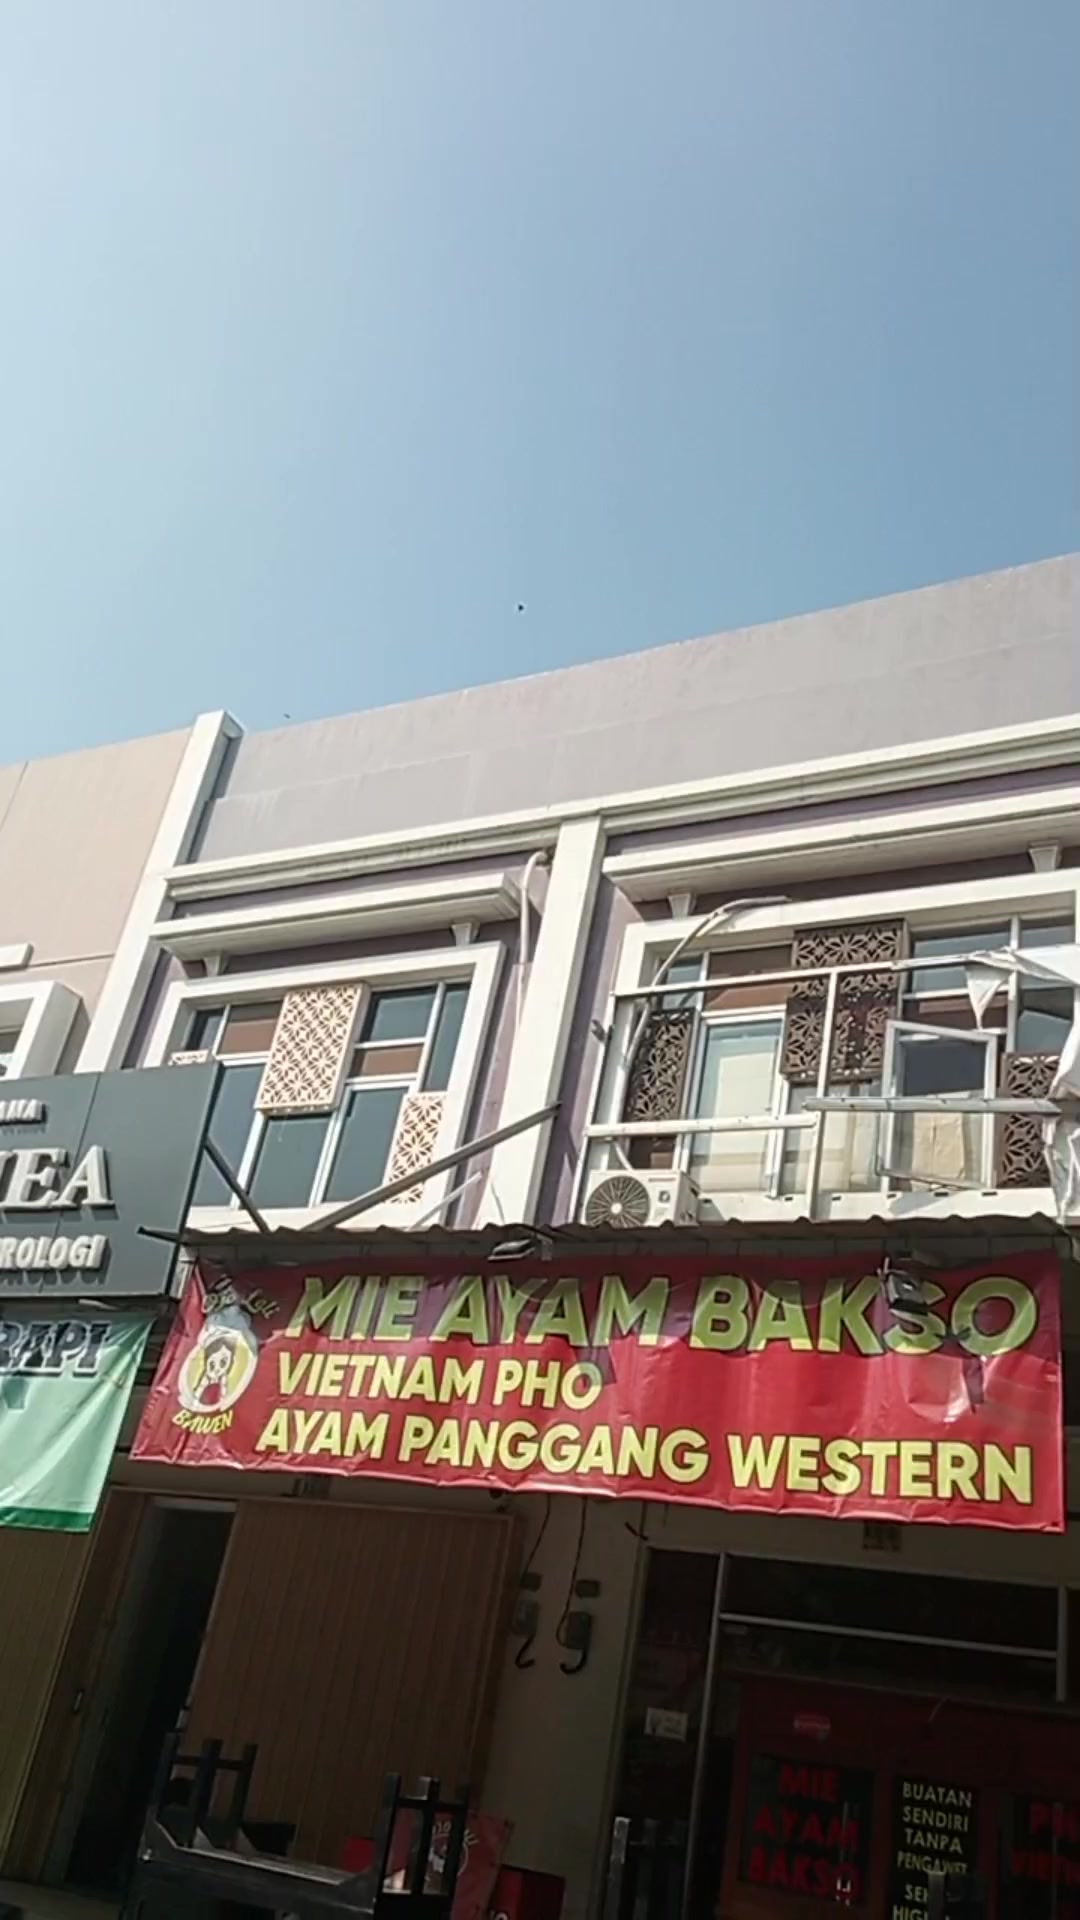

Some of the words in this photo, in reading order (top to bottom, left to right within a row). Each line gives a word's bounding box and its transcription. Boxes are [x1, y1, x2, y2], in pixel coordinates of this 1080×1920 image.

[0, 1145, 115, 1208] EA
[284, 1275, 424, 1341] MIE
[429, 1275, 669, 1348] AYAM
[689, 1274, 1038, 1356] BAKSO
[279, 1352, 484, 1405] VIETNAM
[493, 1358, 604, 1411] PHO
[171, 1408, 234, 1434] BAWEN
[256, 1408, 390, 1459] AYAM
[398, 1415, 709, 1484] PANGGANG
[727, 1433, 1034, 1505] WESTERN
[778, 1763, 840, 1803] MIE
[902, 1782, 973, 1808] BUATAN
[752, 1803, 862, 1853] AYAM
[902, 1806, 969, 1833] SENDIRI
[904, 1828, 963, 1855] TANPA
